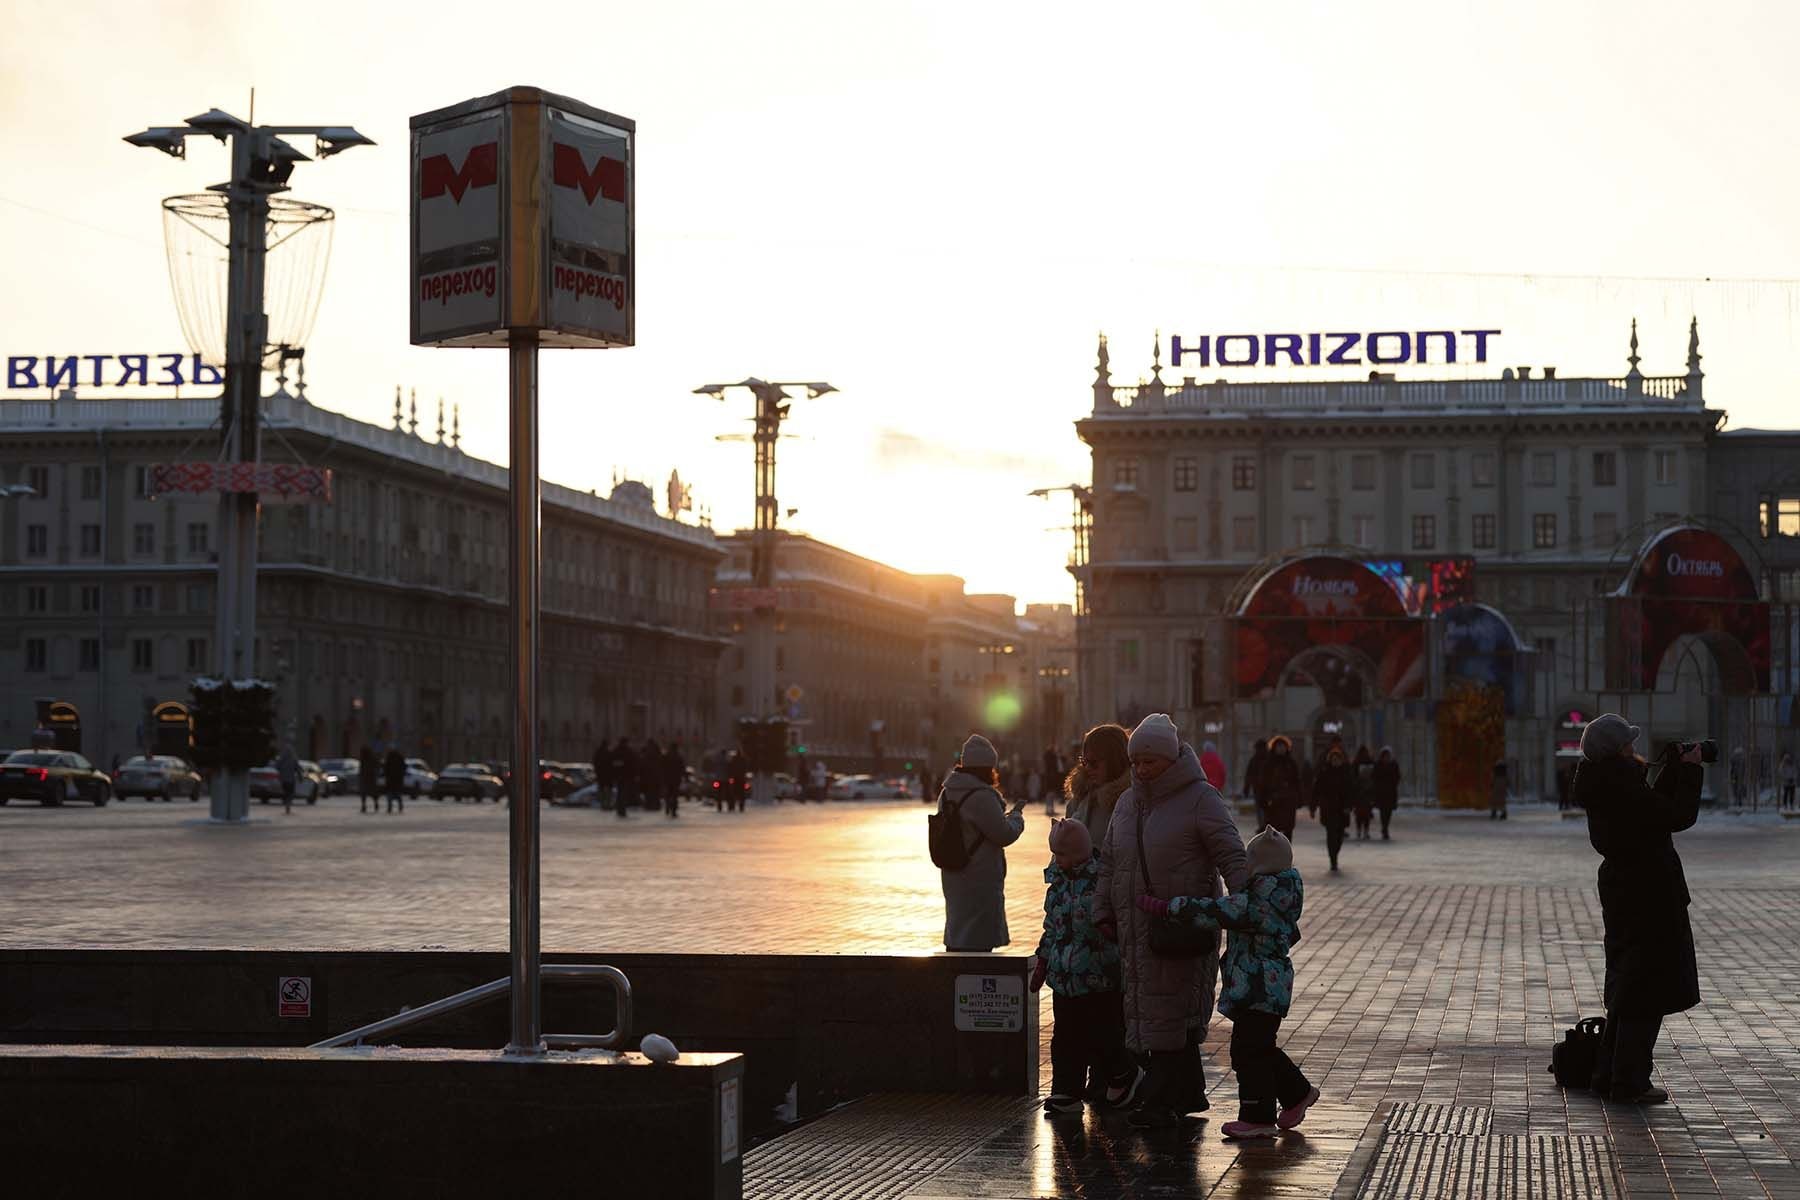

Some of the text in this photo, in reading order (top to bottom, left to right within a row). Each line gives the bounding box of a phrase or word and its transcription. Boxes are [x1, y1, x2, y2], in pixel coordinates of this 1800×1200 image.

[421, 265, 497, 305] переход
[554, 264, 625, 310] переход
[1171, 330, 1502, 367] HORIZONT
[7, 353, 225, 388] ВИТЯЗЬ
